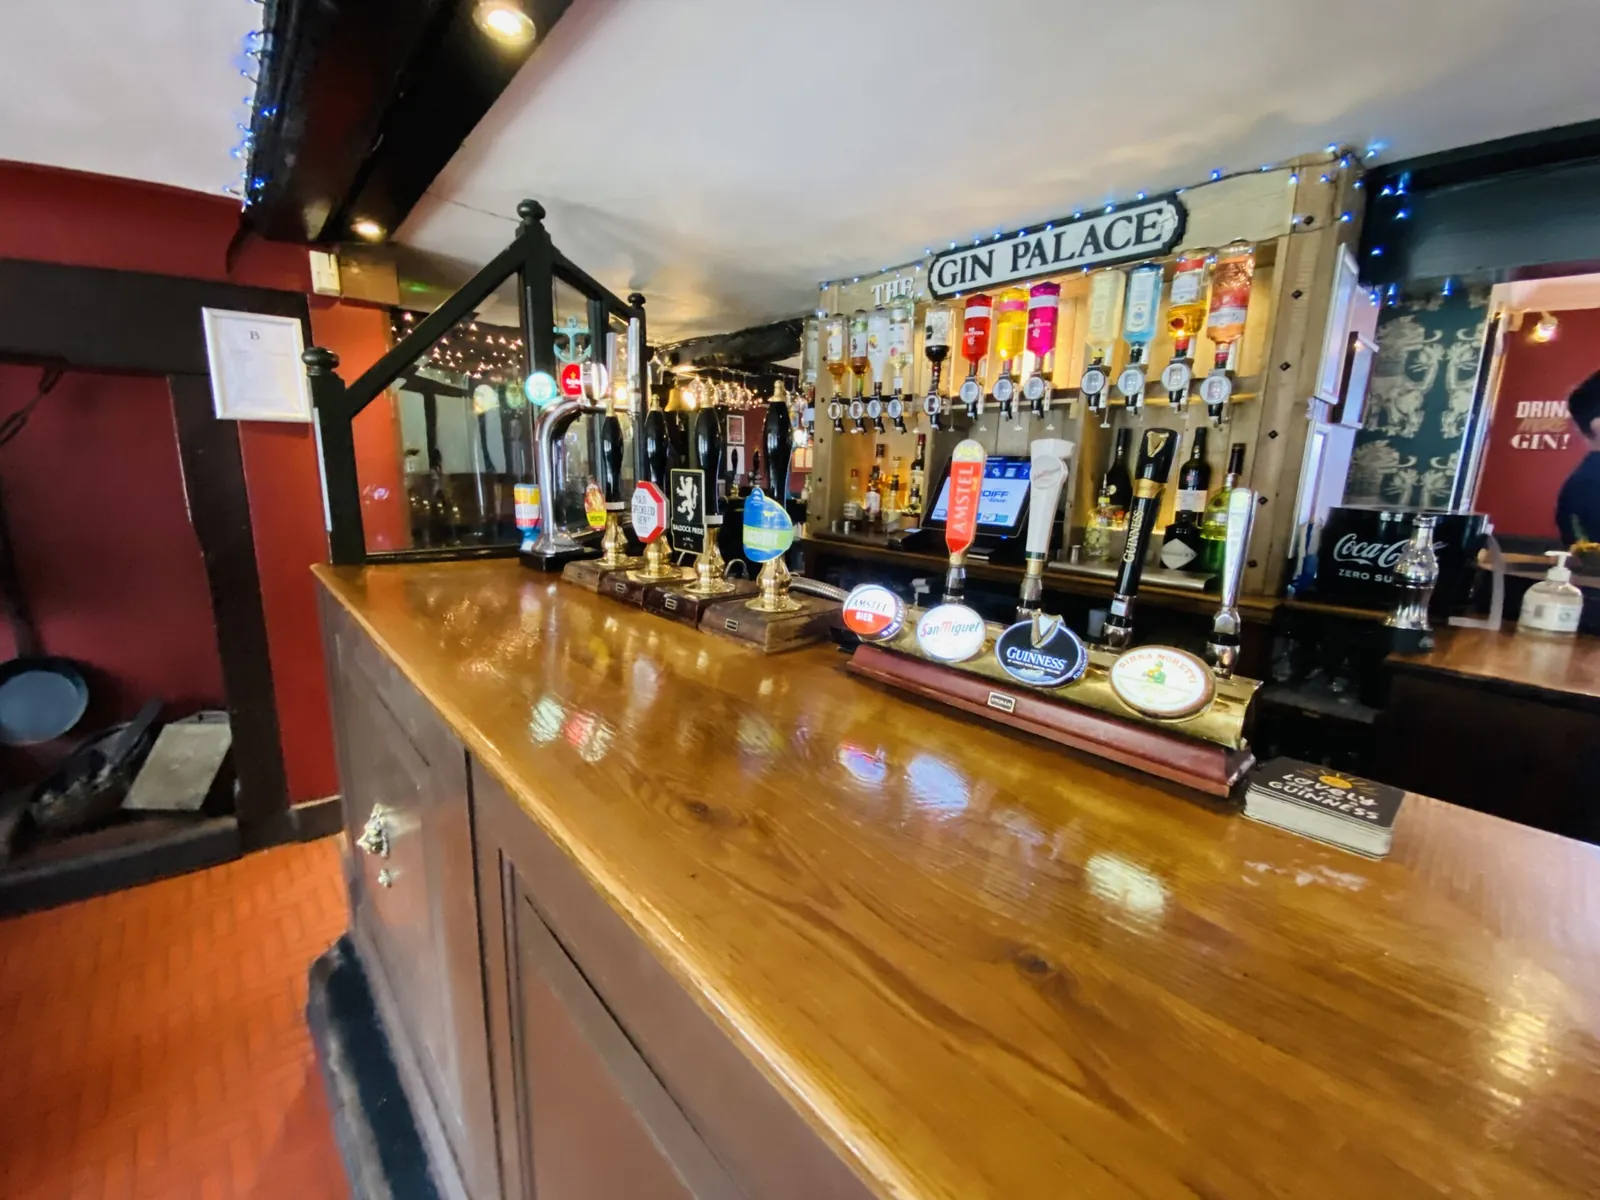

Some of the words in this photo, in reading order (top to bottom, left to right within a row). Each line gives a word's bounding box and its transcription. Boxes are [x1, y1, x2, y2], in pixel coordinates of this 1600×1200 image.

[937, 250, 996, 288] GIN
[1009, 207, 1164, 273] PALACE
[870, 277, 915, 307] THE
[249, 331, 260, 340] B
[1510, 433, 1571, 450] GIN!
[952, 466, 975, 534] AMSTEL
[1123, 510, 1145, 563] GUINNESS
[1333, 533, 1413, 568] Coca-C
[1338, 568, 1370, 580] ZERO
[1374, 574, 1393, 583] SU
[855, 610, 875, 623] BIER
[1006, 646, 1065, 670] GUINNESS
[1268, 781, 1379, 820] GUINNESS
[1282, 773, 1379, 806] LOVELY
